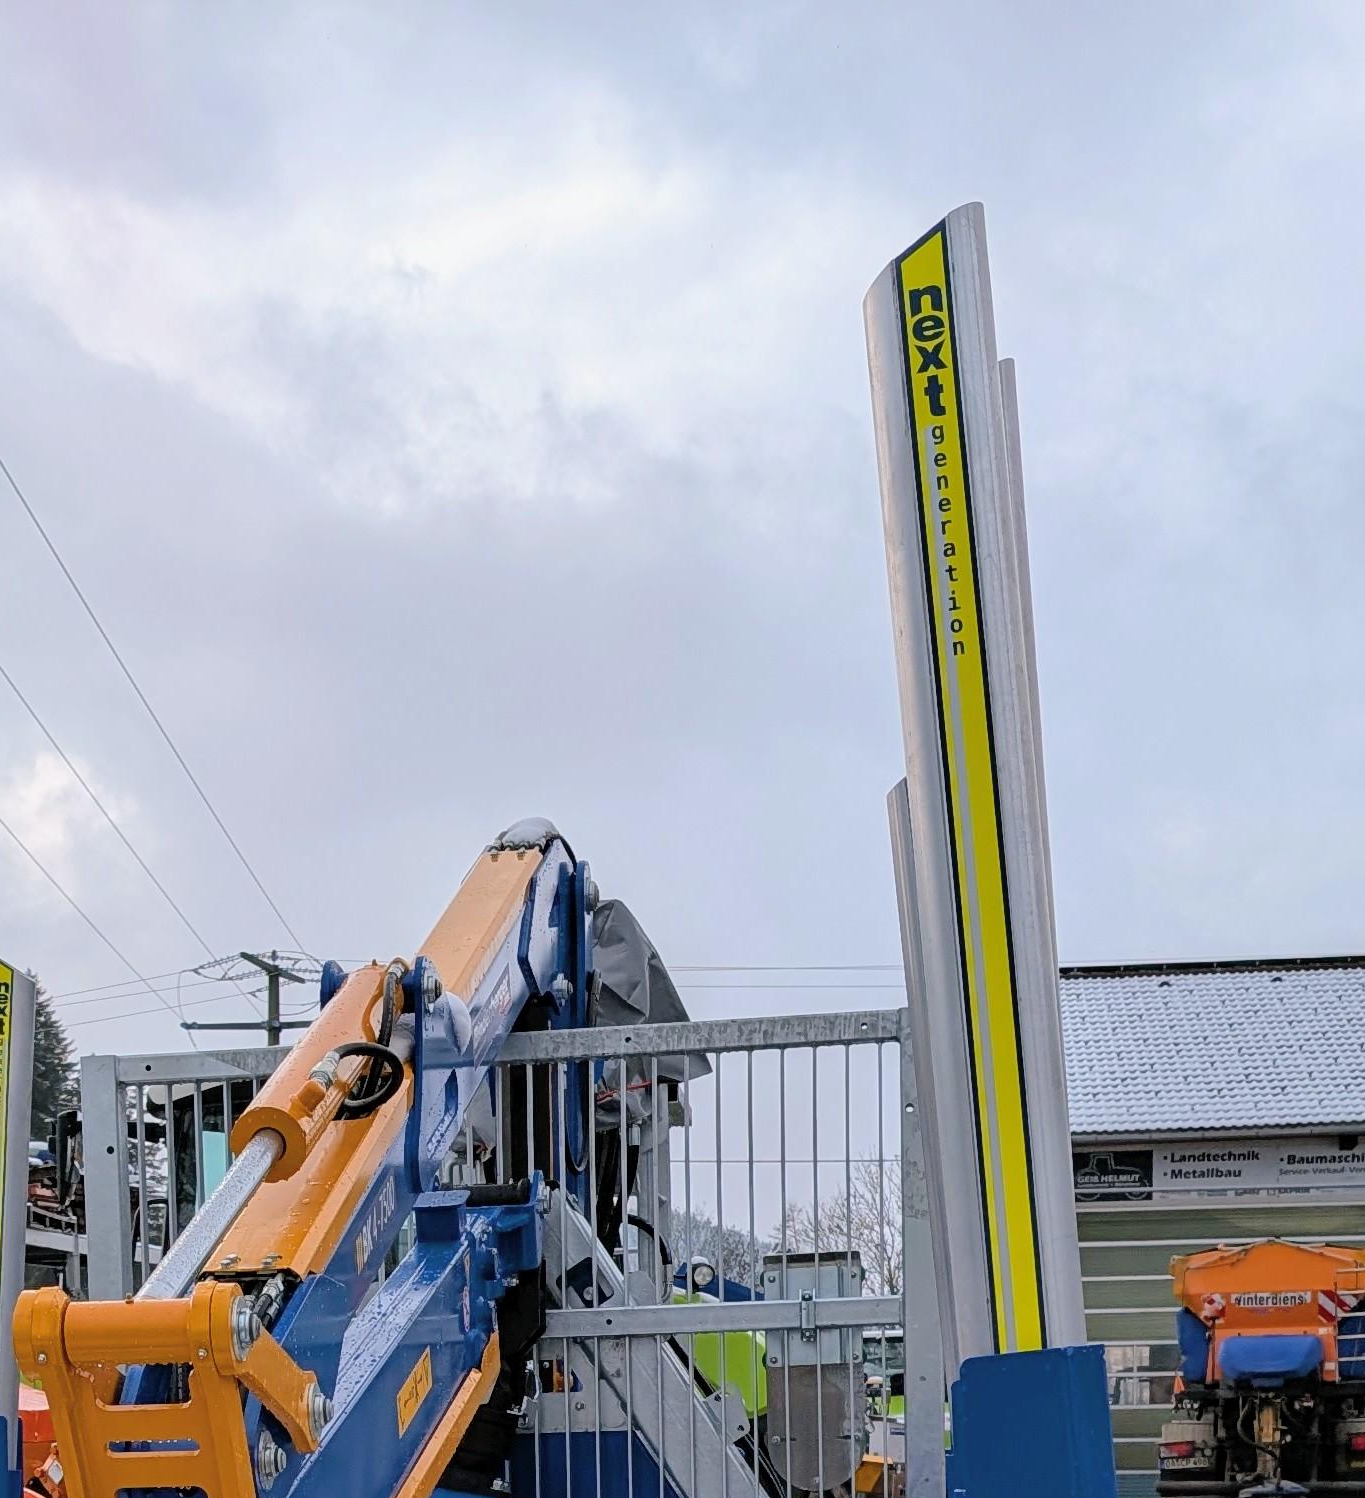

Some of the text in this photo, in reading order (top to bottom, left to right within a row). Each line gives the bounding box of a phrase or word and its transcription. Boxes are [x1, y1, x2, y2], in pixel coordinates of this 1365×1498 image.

[908, 283, 965, 657] next generation
[1170, 1150, 1260, 1163] Landtechnik
[1170, 1167, 1242, 1180] Metallbau
